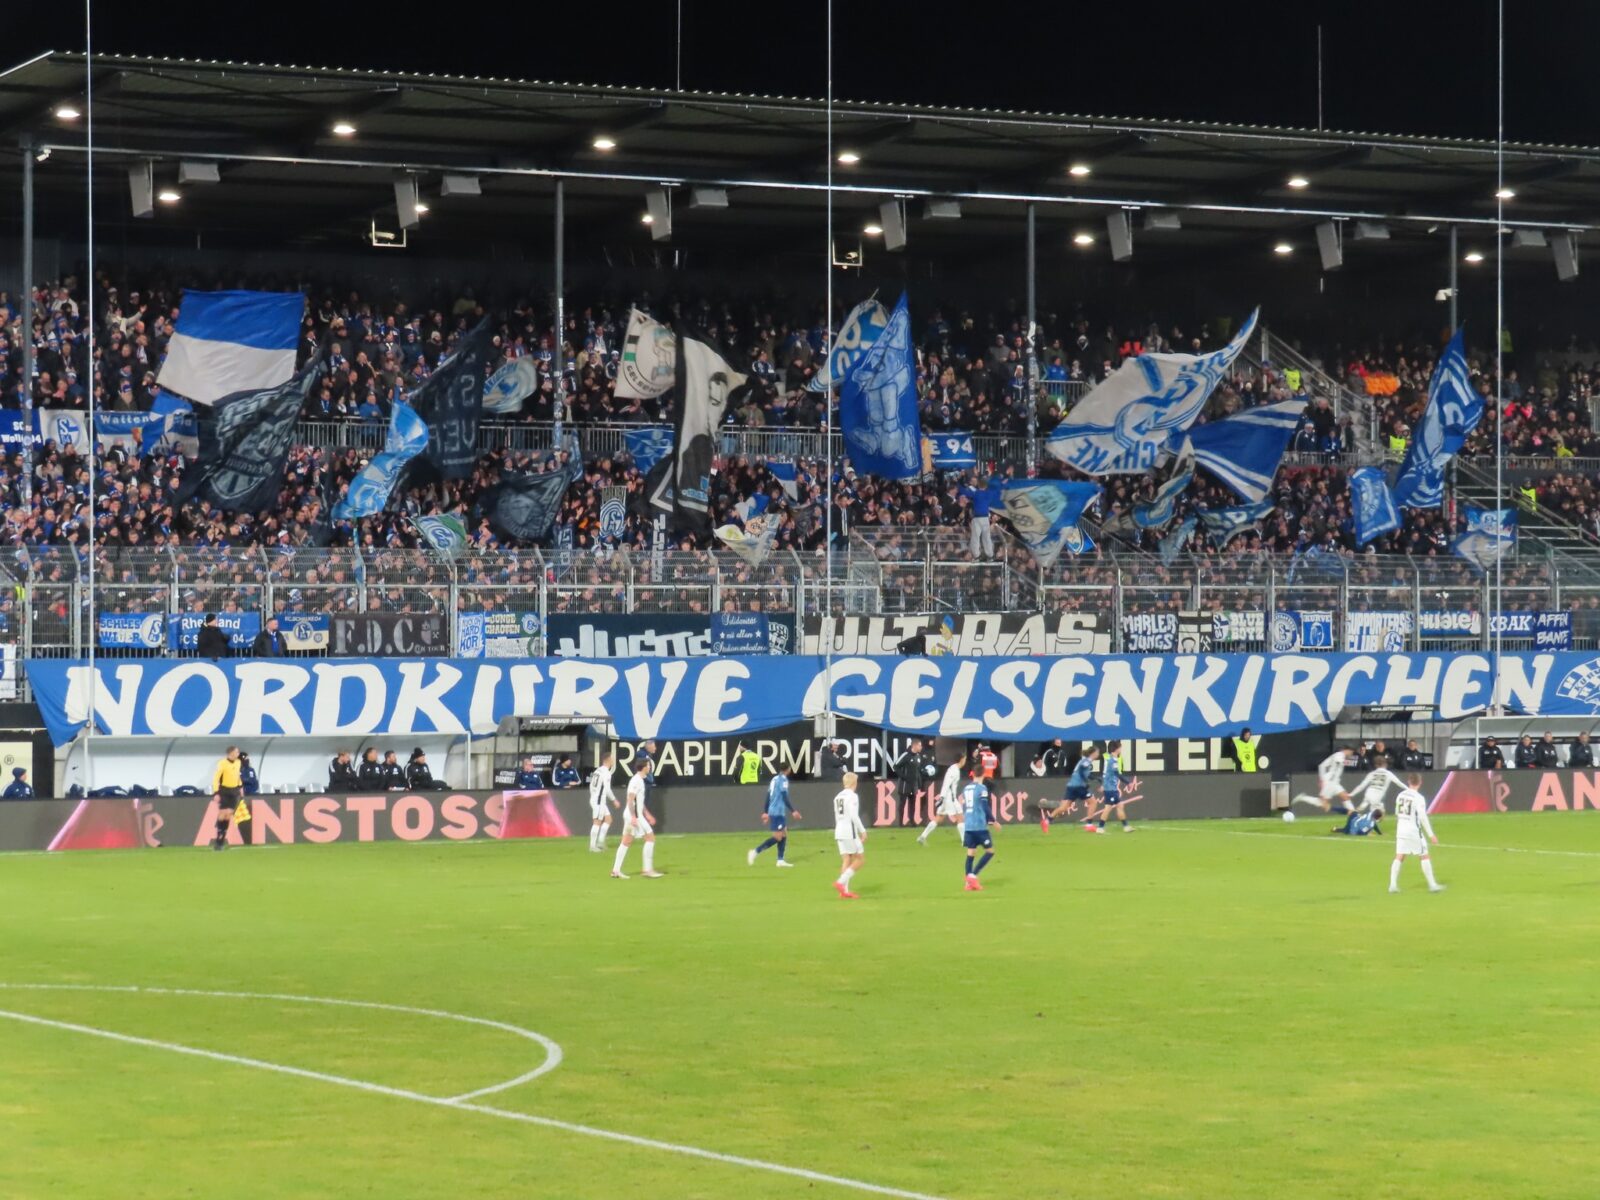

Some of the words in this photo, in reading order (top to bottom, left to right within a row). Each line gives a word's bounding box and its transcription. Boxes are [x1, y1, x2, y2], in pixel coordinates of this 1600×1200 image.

[946, 438, 972, 454] 94
[1122, 613, 1178, 633] MARLER
[1230, 612, 1265, 626] BLUE
[1346, 612, 1406, 635] SUPPORTERS
[233, 633, 244, 644] 04
[461, 627, 479, 638] HARD
[1129, 635, 1174, 650] JUNGS
[1346, 634, 1378, 652] CLUB
[64, 659, 750, 738] NORDKURVE
[802, 655, 1554, 735] GELSENKIRCHEN
